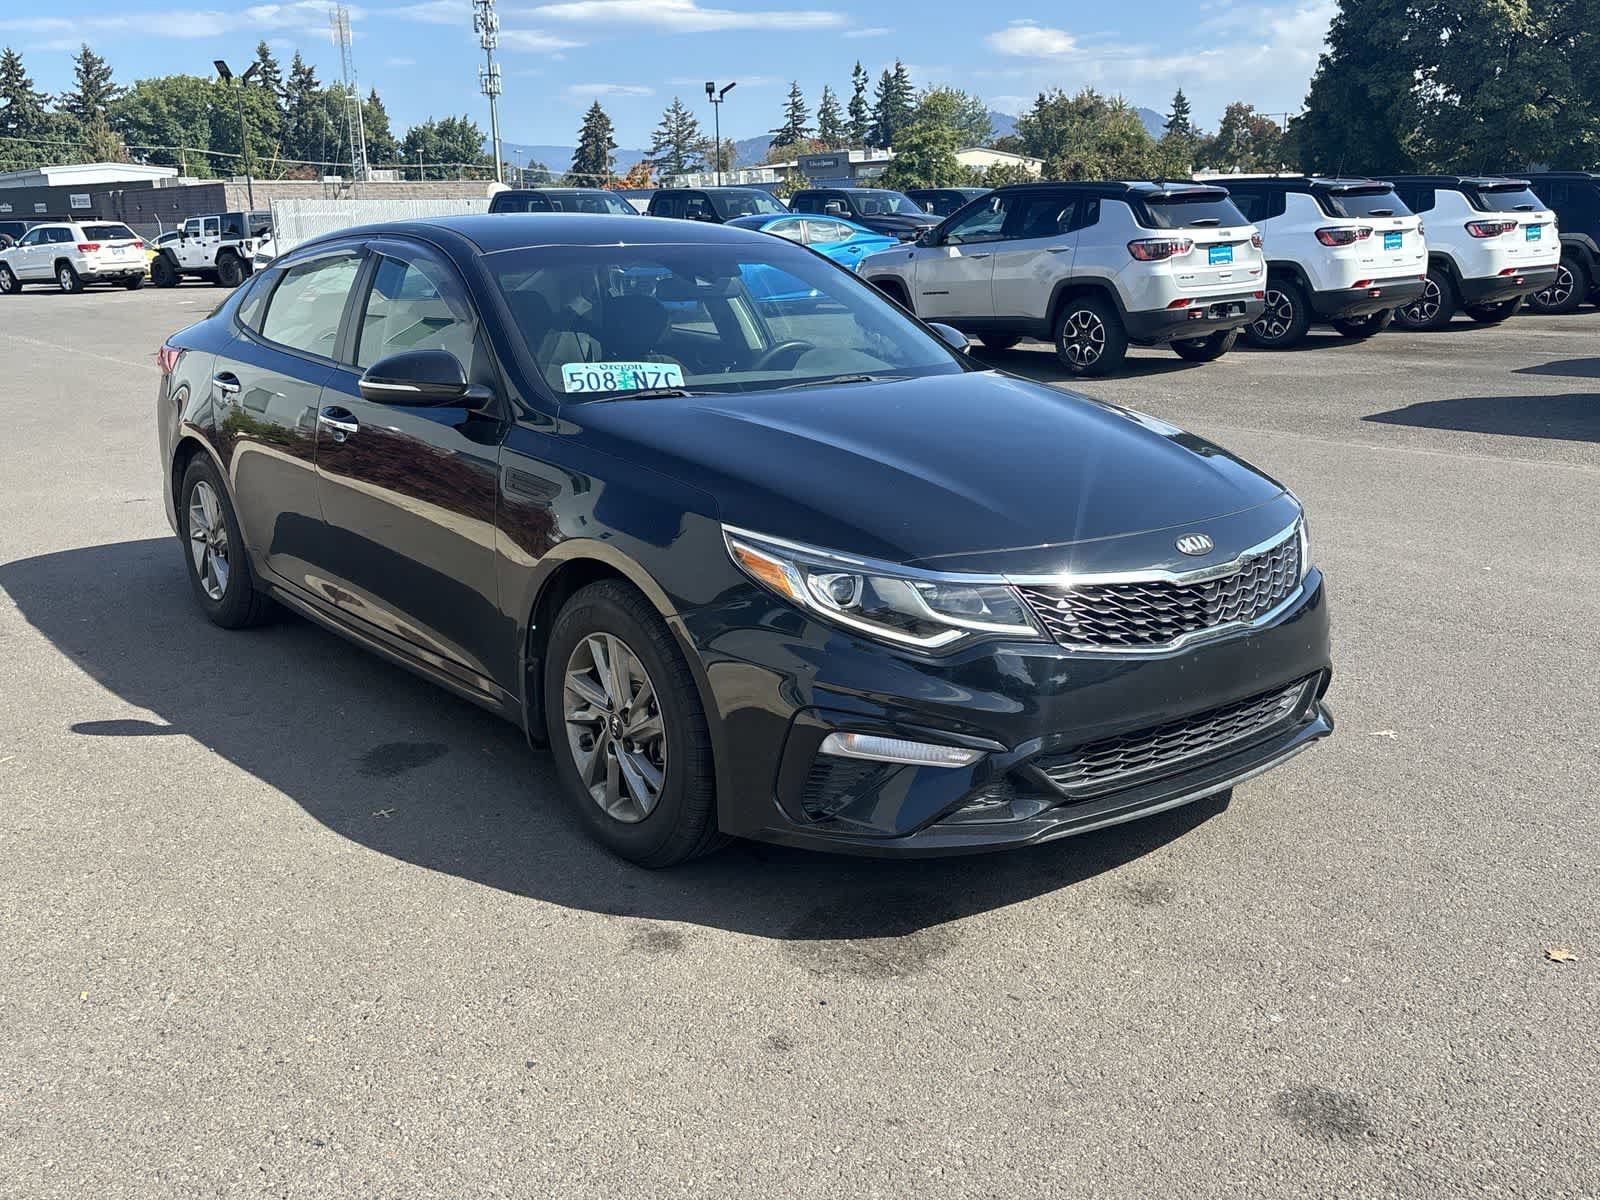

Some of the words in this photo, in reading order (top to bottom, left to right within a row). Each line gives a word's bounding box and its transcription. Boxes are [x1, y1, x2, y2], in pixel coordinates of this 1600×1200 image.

[599, 364, 643, 372] Oregon
[569, 371, 617, 392] 508
[1177, 535, 1212, 552] KIA
